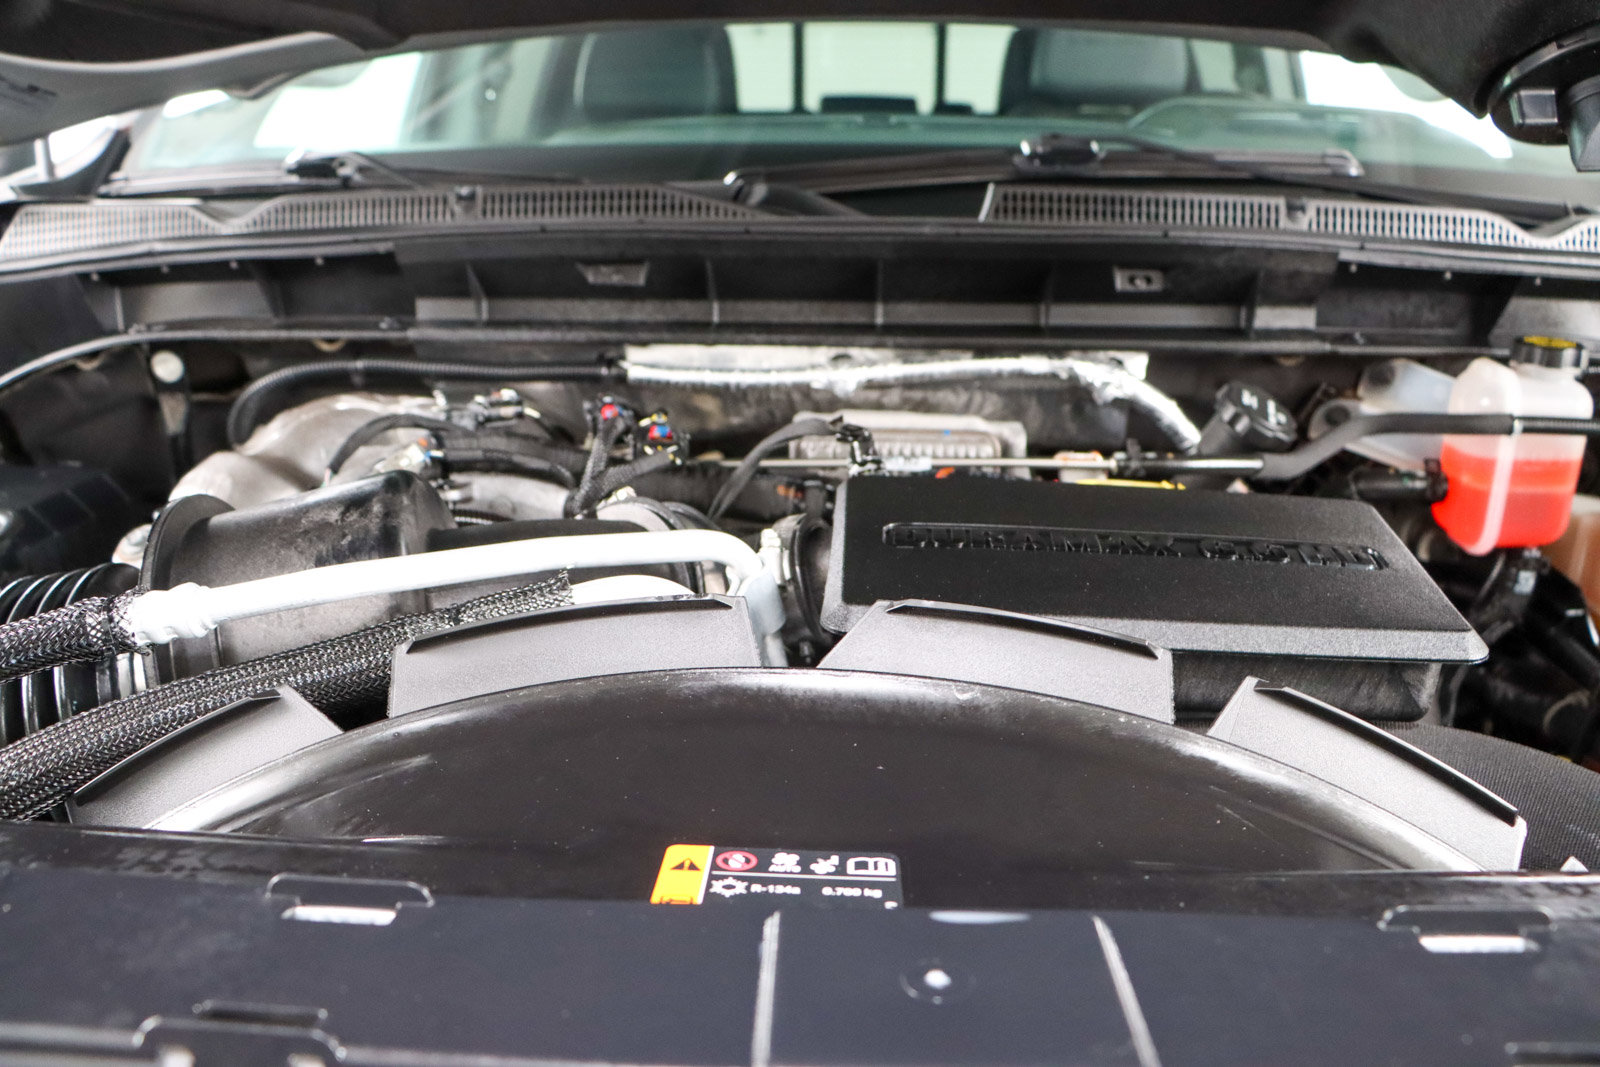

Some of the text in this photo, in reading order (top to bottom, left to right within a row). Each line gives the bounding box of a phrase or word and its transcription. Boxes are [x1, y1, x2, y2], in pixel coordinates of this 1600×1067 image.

[890, 526, 1184, 557] DURAMAX
[768, 865, 802, 873] AUTO
[750, 883, 801, 895] R-134a
[863, 888, 883, 899] kg
